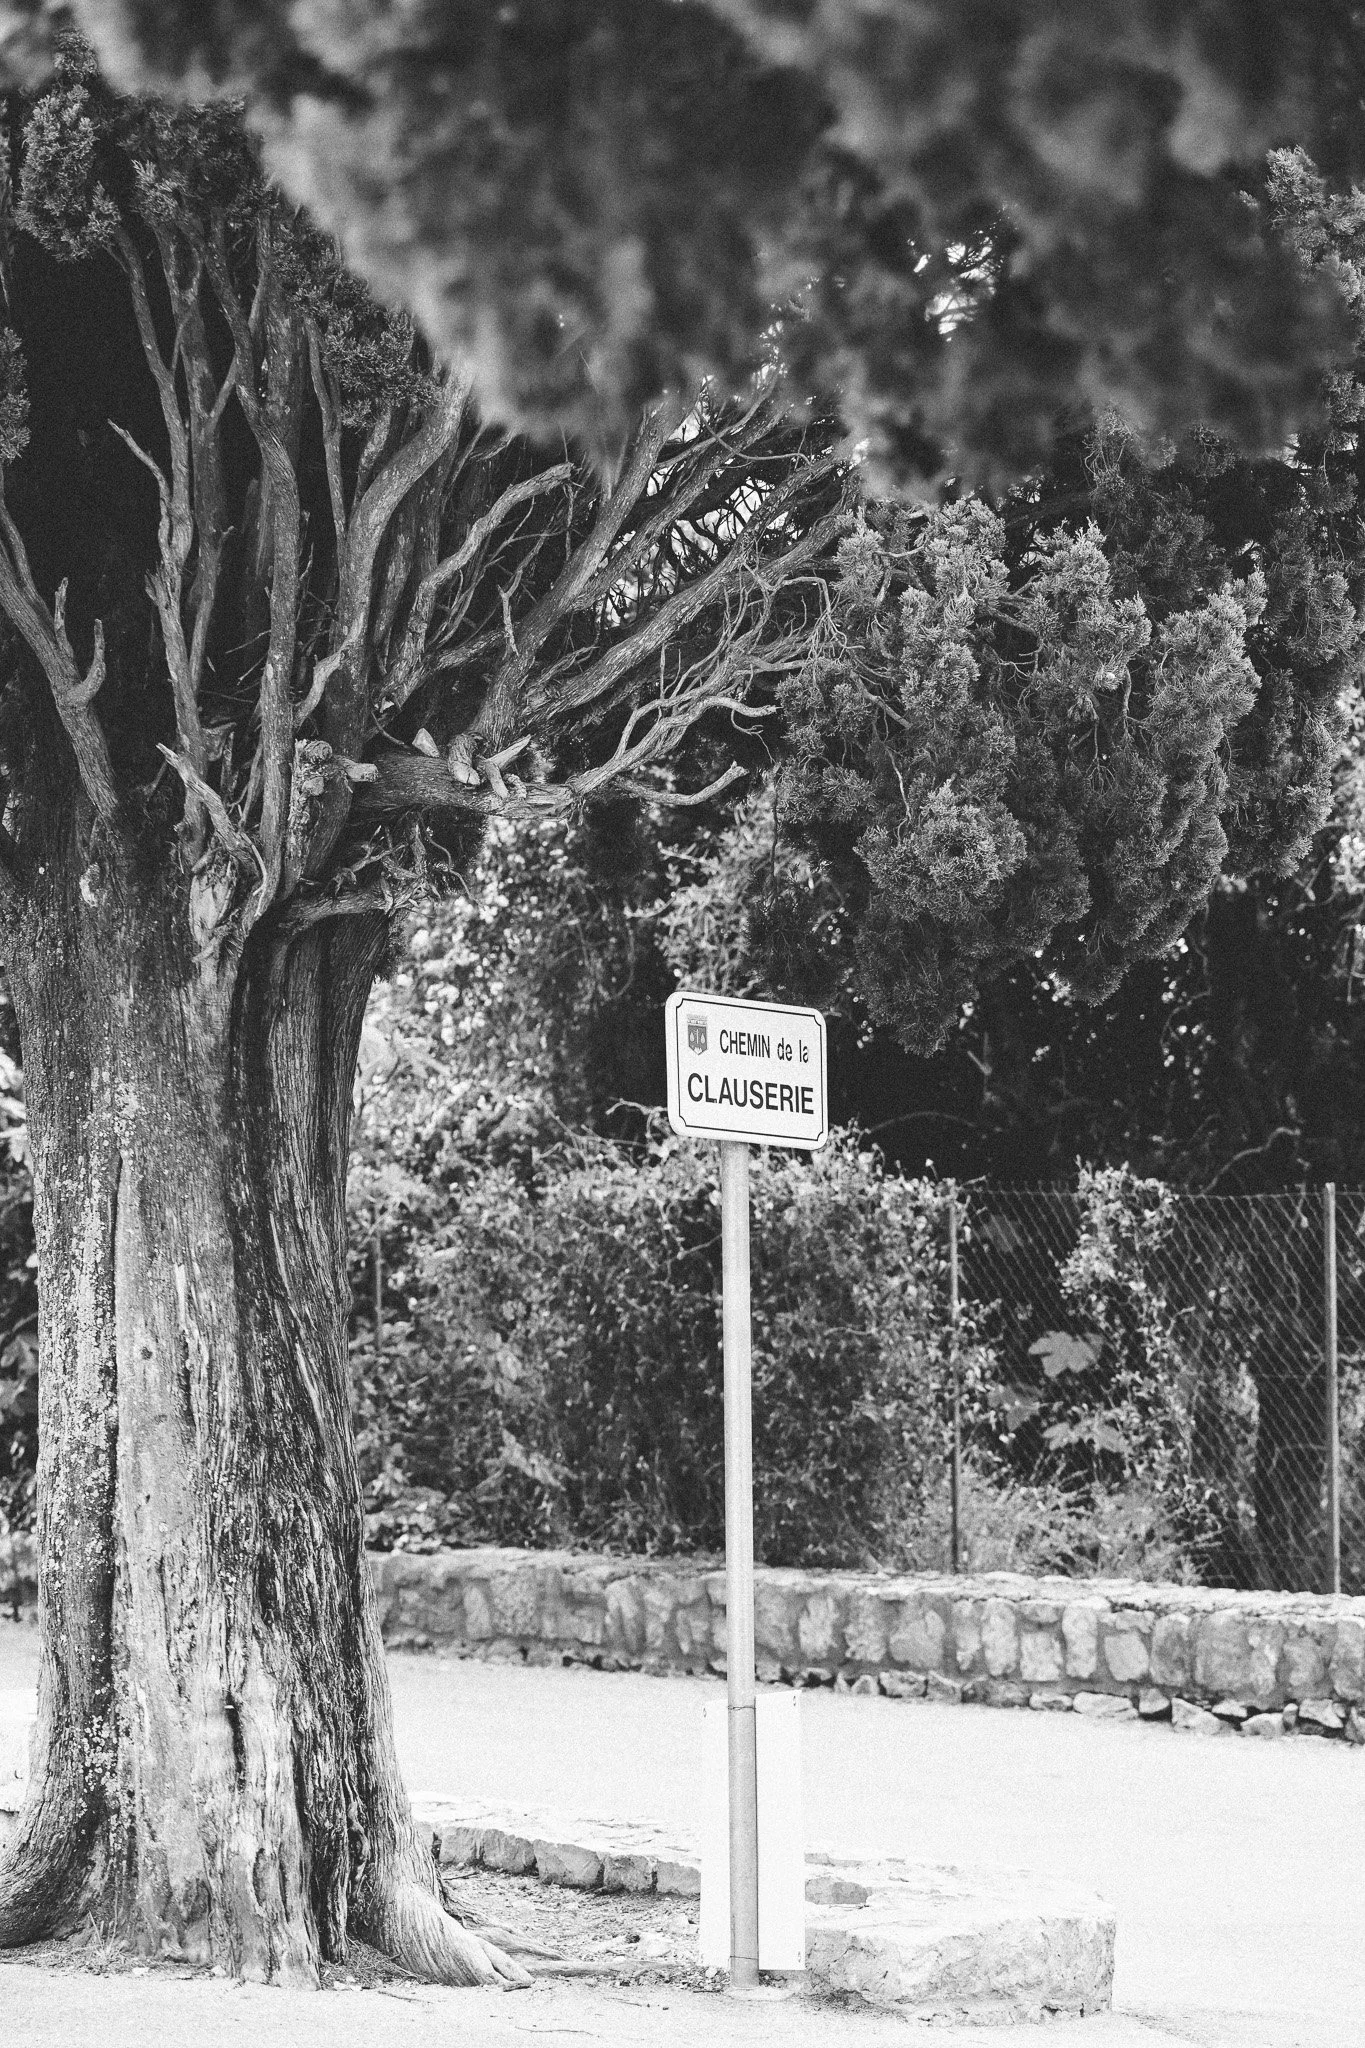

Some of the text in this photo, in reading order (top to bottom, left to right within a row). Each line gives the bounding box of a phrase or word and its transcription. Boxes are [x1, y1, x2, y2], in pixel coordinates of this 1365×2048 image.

[719, 1029, 809, 1063] CHEMIN de la
[687, 1072, 814, 1115] CLAUSERIE
